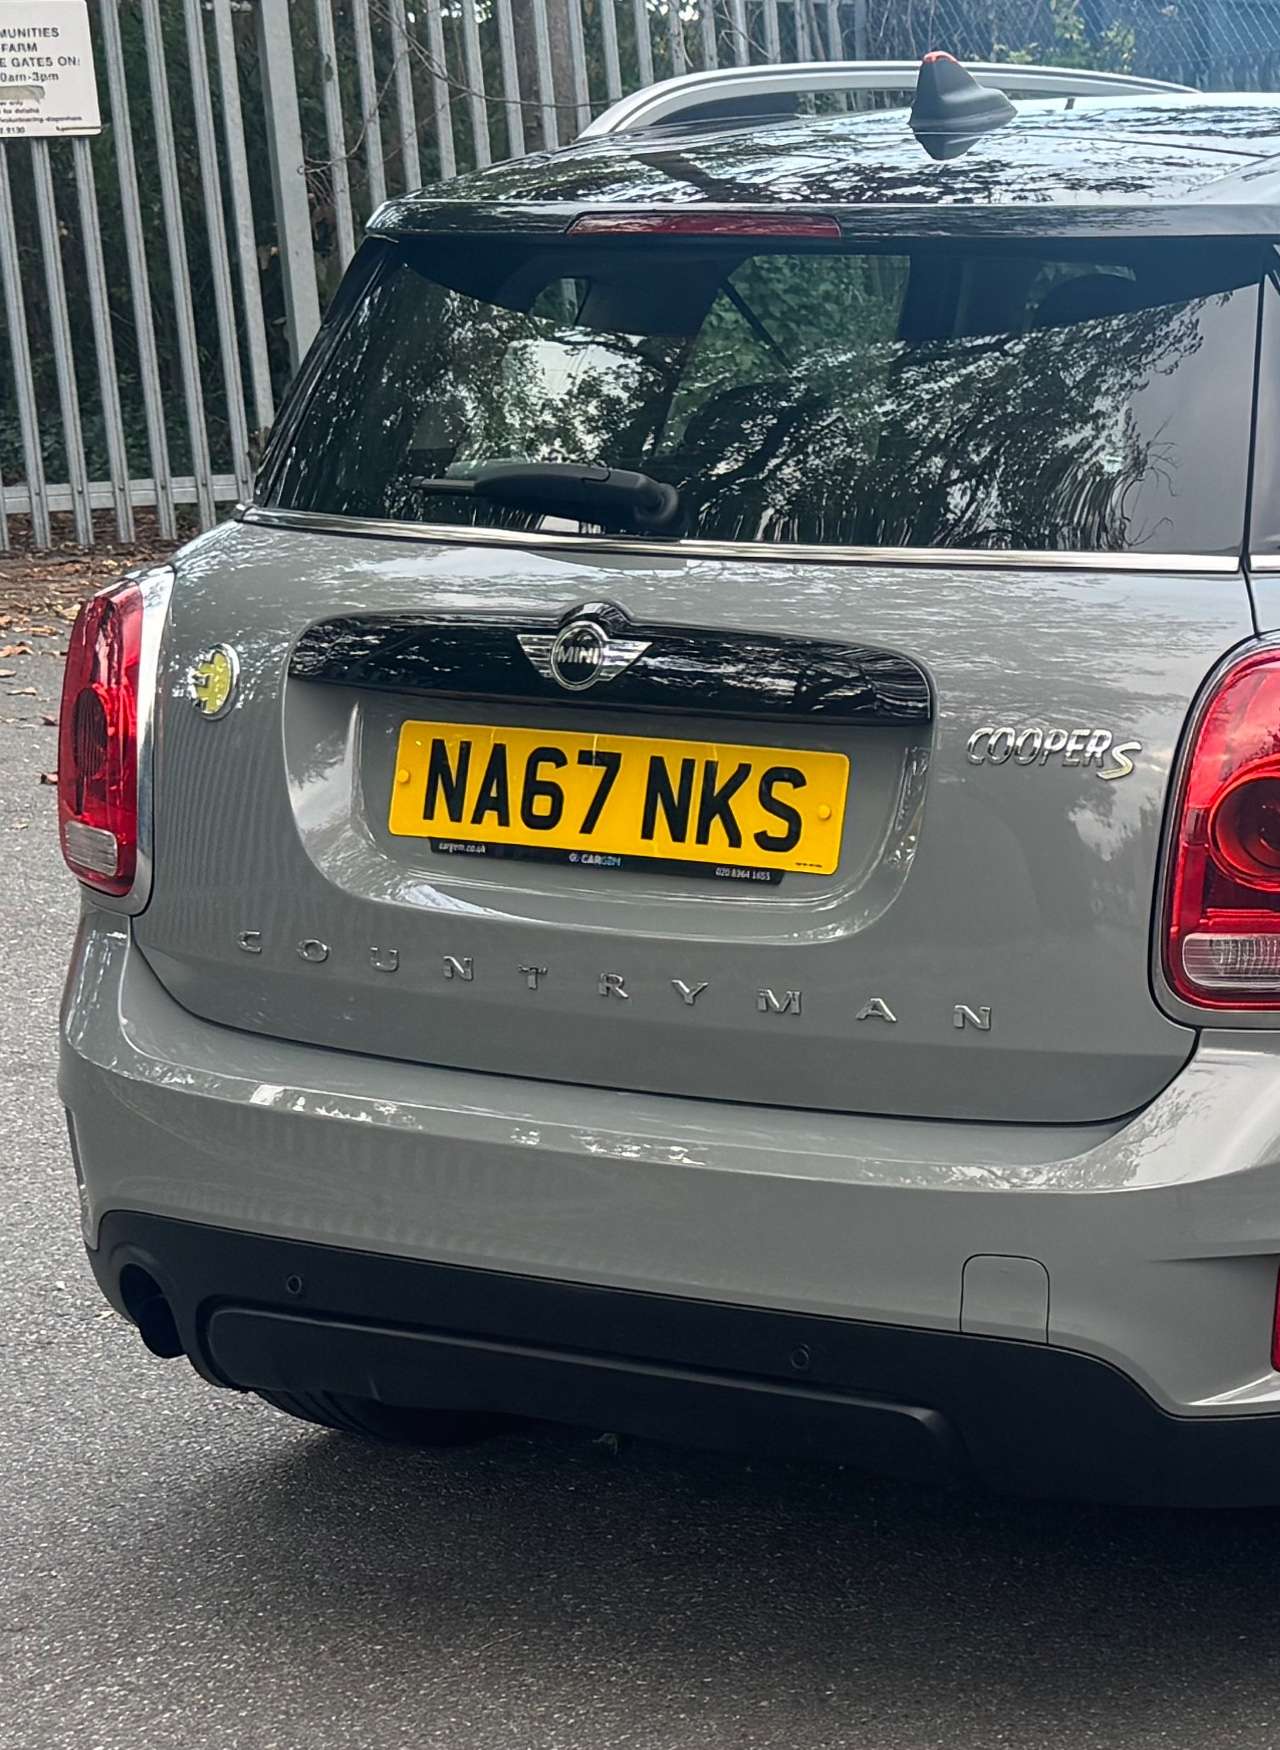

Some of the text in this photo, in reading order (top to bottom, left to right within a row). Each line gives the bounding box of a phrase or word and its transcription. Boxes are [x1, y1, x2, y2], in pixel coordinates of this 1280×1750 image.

[1, 42, 38, 52] FARM
[11, 57, 53, 67] GATES
[557, 645, 600, 665] MINI
[967, 726, 1142, 781] COOPER S
[422, 737, 807, 853] NA67 NKS
[235, 930, 993, 1032] COUNTRYMAN
